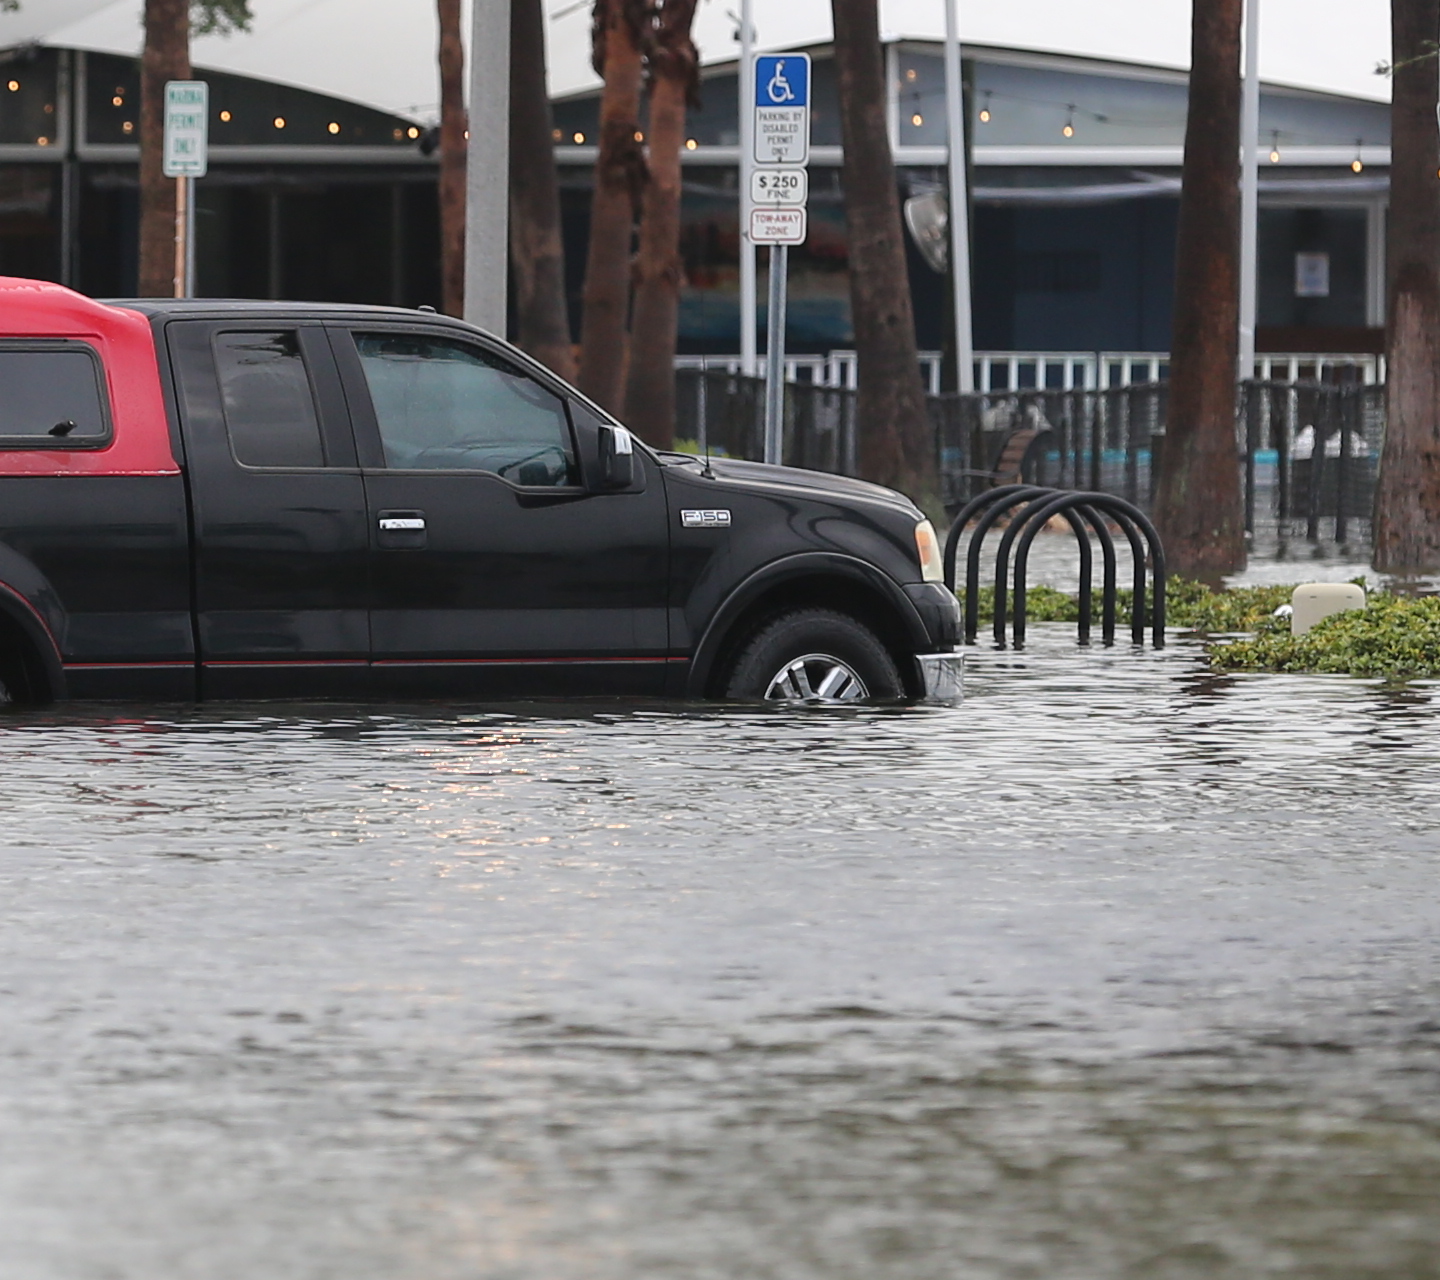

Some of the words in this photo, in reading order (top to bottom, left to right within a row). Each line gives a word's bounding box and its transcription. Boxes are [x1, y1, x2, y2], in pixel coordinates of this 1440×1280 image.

[760, 111, 790, 121] PARKING
[793, 111, 802, 121] BY
[762, 123, 799, 133] DISABLED
[767, 135, 793, 145] PERMIT
[771, 147, 789, 156] ONLY
[767, 190, 791, 199] FINE
[755, 214, 800, 224] TOW-AWAY
[765, 226, 789, 236] ZONE
